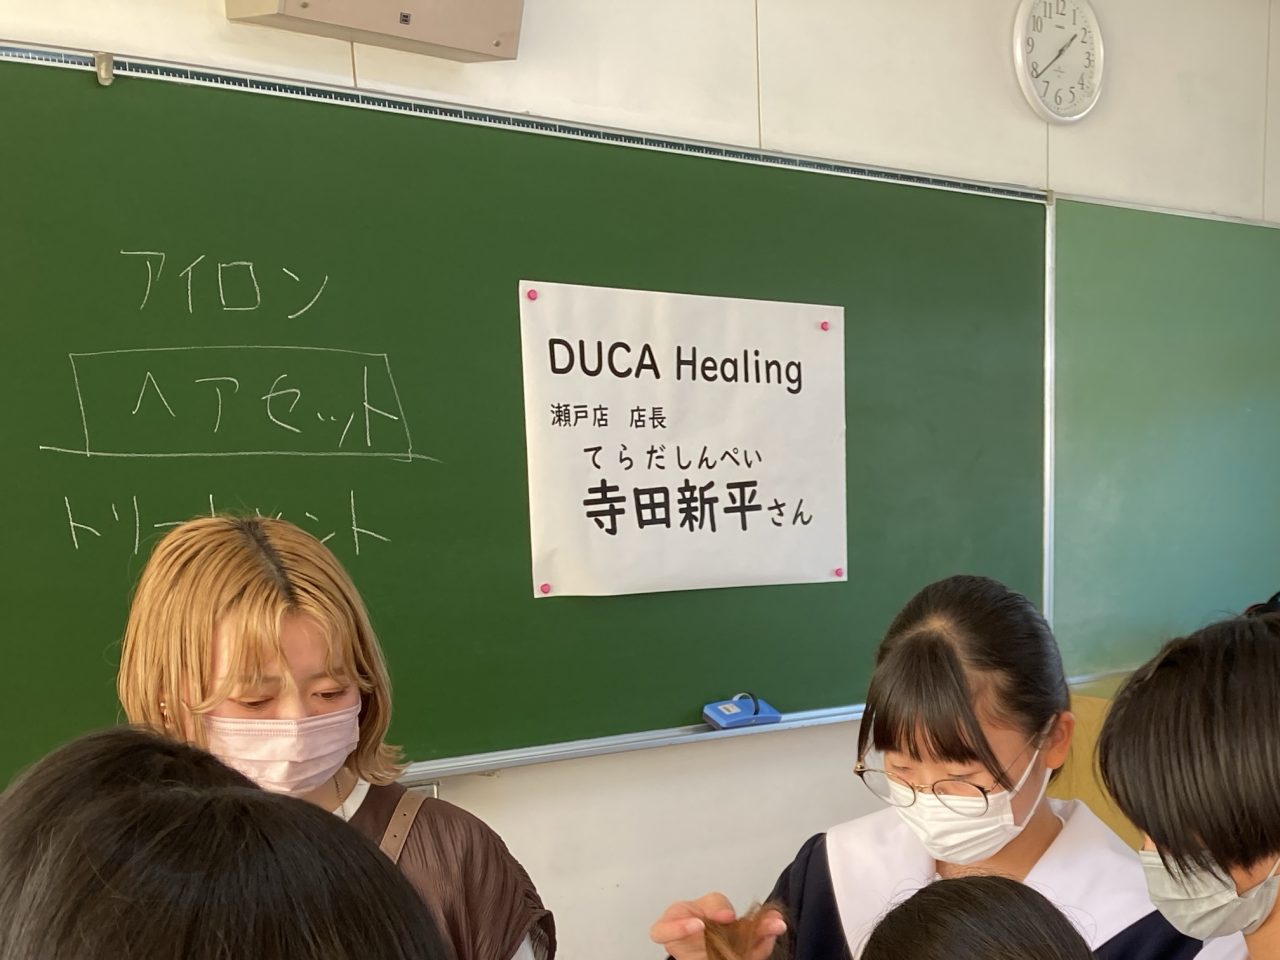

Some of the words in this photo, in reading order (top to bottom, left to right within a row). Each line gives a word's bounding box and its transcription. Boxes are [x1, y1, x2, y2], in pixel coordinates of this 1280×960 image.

[120, 249, 328, 319] アイロン
[547, 337, 661, 380] DUCA
[675, 345, 803, 395] Healing
[132, 366, 399, 448] ヘアセット
[550, 403, 609, 428] 瀬戸店
[629, 405, 667, 430] 店長
[583, 444, 763, 471] てらだしんぺい
[64, 489, 392, 555] トリーント
[583, 478, 813, 536] 寺田新平さん
